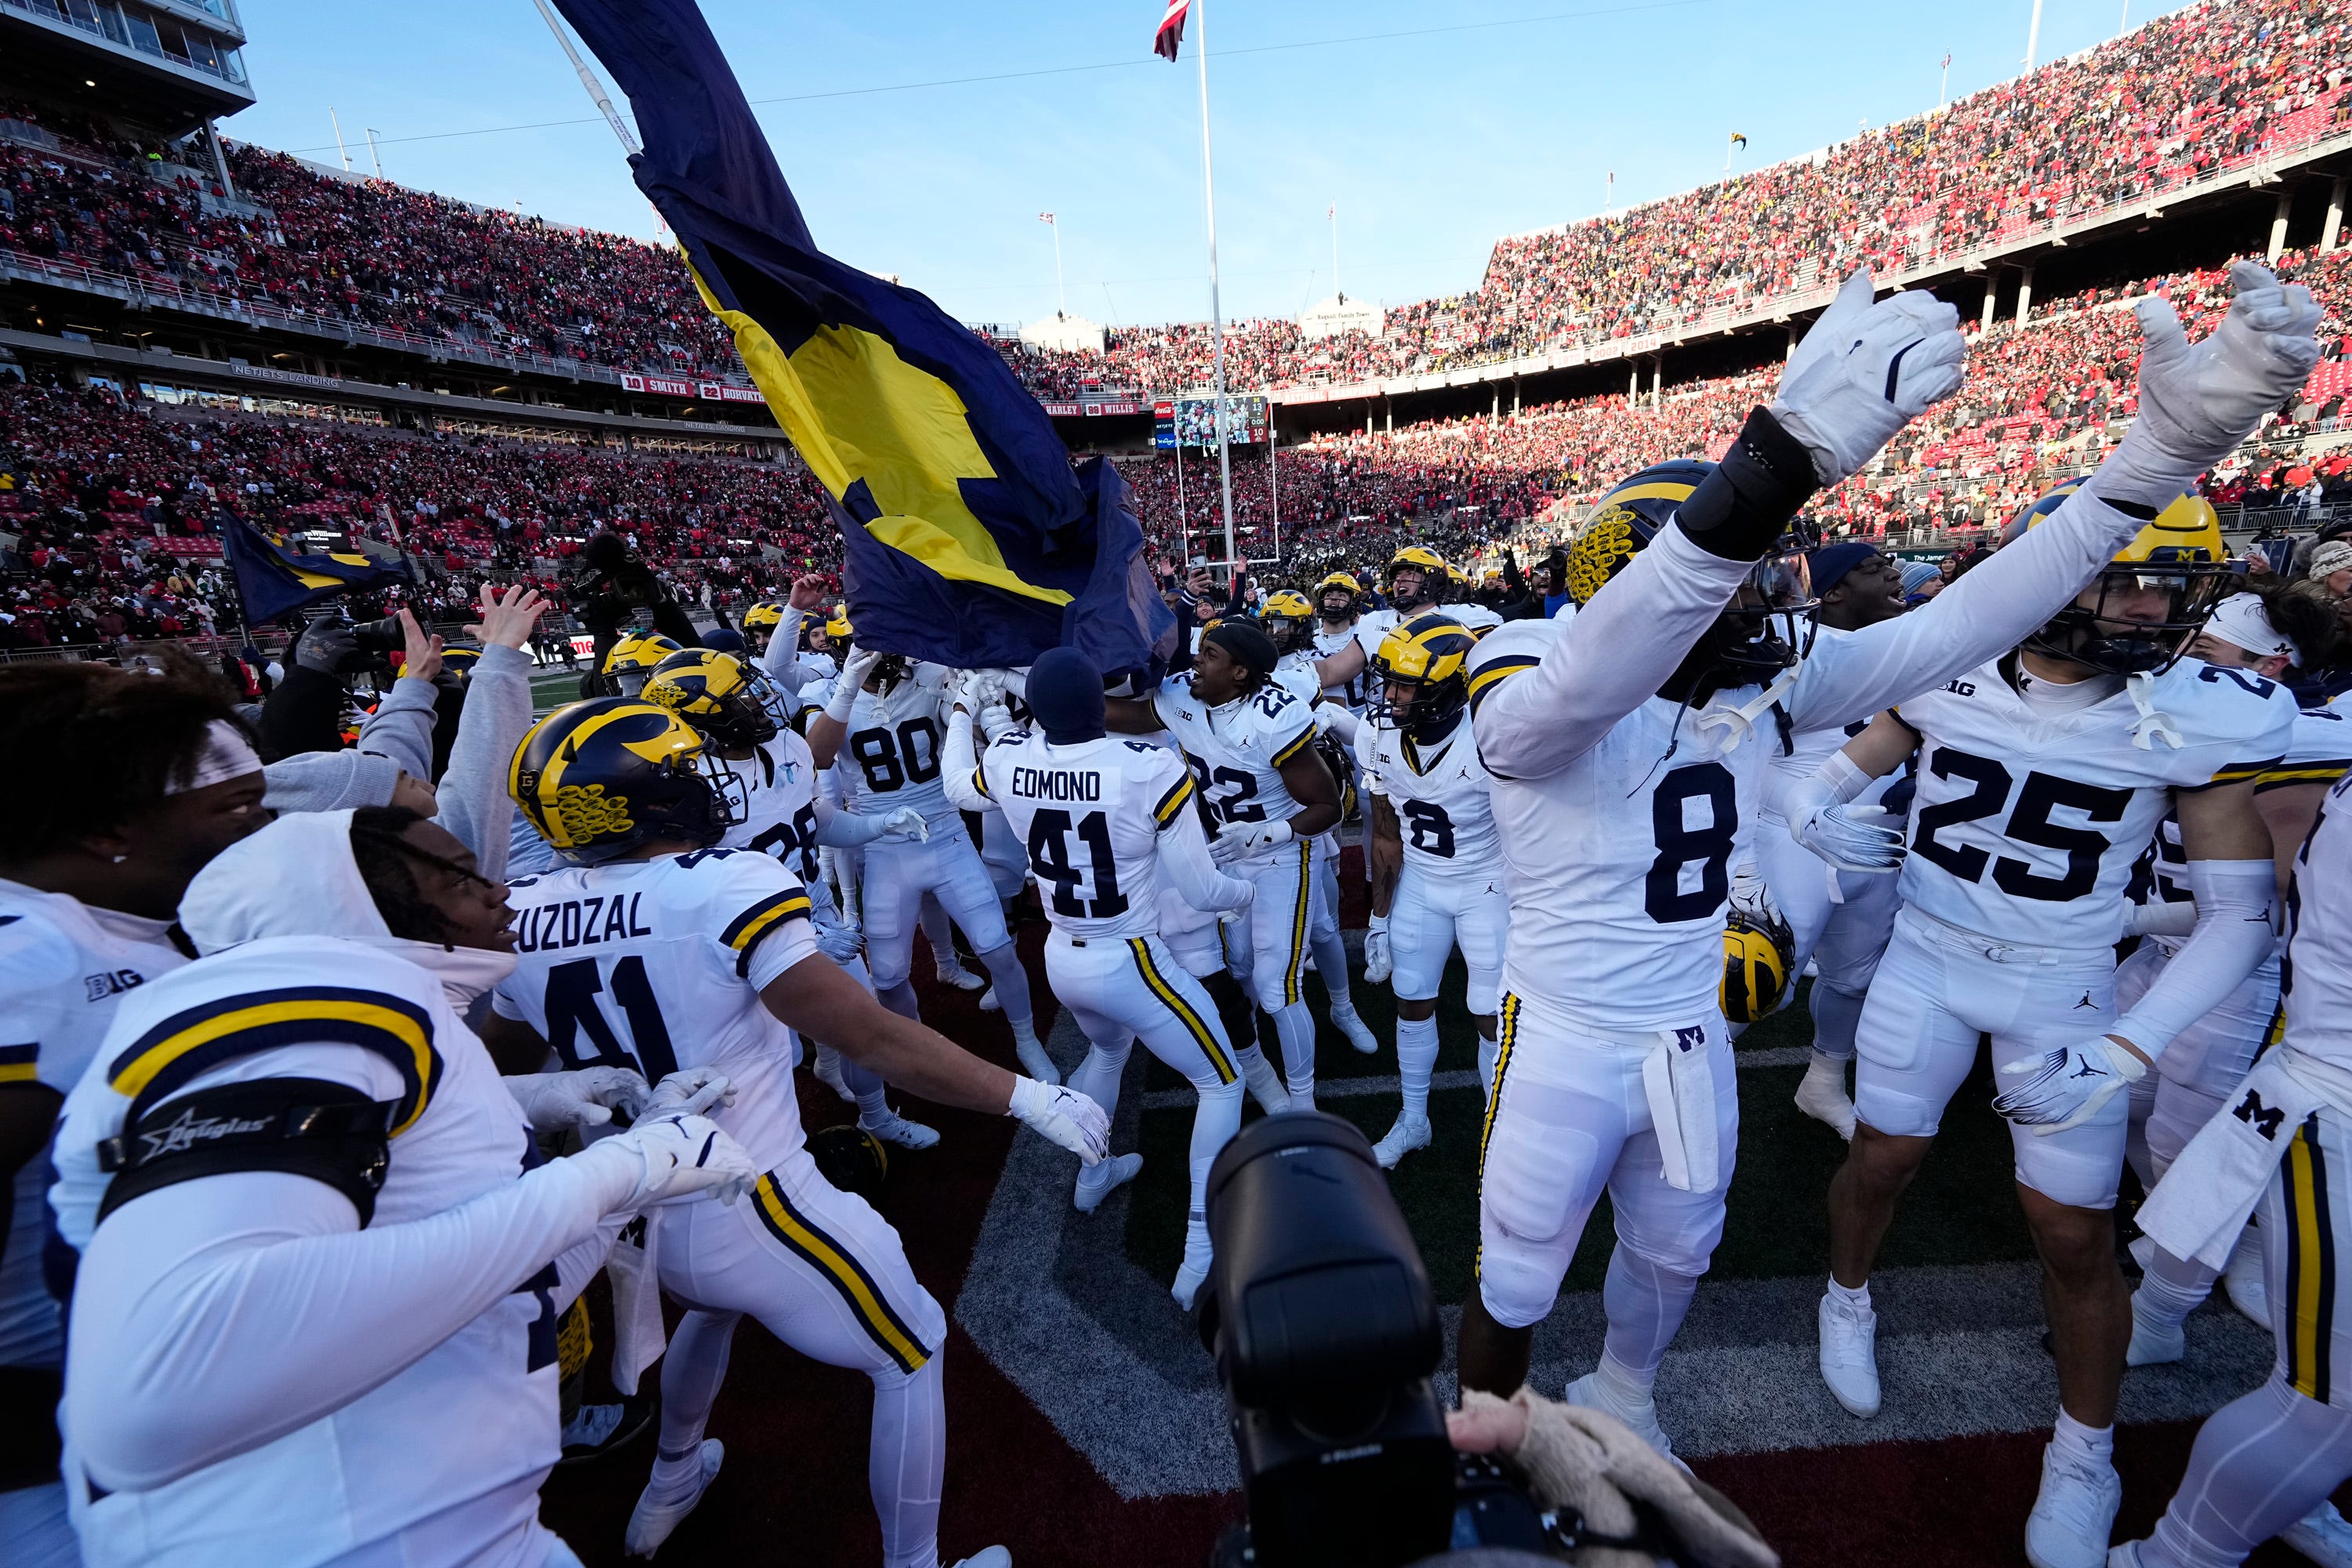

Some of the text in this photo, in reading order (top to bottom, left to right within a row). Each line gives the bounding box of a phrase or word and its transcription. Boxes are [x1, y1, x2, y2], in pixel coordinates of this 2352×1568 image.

[1594, 347, 1618, 359] 2002
[1631, 339, 1657, 351] 2014
[235, 366, 338, 387] NETJETS LANDING
[626, 377, 687, 394] 10 SMITH
[703, 387, 719, 397] 22
[1046, 405, 1077, 415] HARLEY
[1105, 405, 1134, 414] WILLIS
[1253, 403, 1262, 412] 13
[1284, 391, 1326, 402] NATIONAL
[2176, 550, 2196, 561] M
[1254, 688, 1298, 720] 22
[850, 716, 942, 793] 80
[1012, 767, 1100, 801] EDMOND
[1185, 750, 1268, 823] 22
[1403, 798, 1456, 859] 8
[1911, 746, 2134, 902] 25
[1645, 762, 1738, 924] 8
[1028, 808, 1129, 918] 41
[516, 891, 652, 953] UZDZAL
[544, 956, 679, 1091] 41
[1671, 1025, 1705, 1053] M
[2232, 1087, 2285, 1142] M
[164, 1116, 275, 1148] Douglas
[617, 1214, 648, 1250] M
